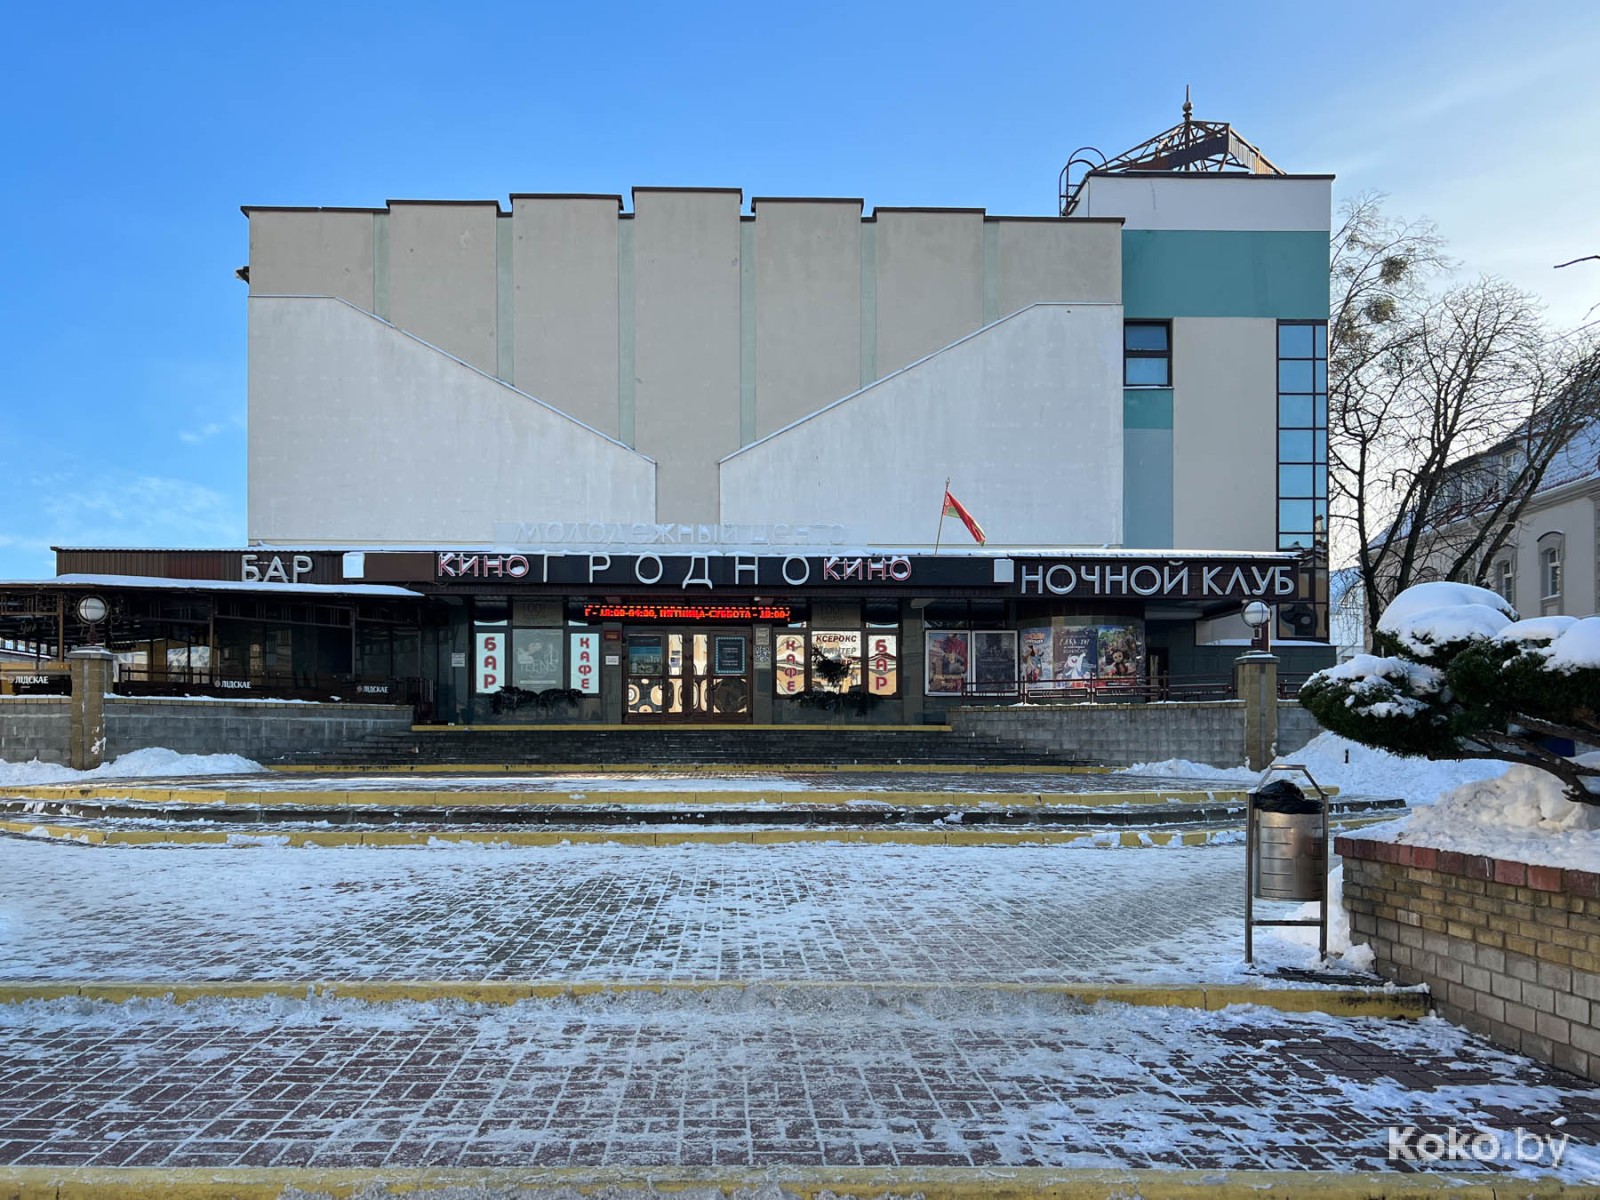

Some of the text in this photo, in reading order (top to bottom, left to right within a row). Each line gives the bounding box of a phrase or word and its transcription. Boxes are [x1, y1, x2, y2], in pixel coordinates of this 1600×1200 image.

[241, 555, 313, 583] БАР
[437, 552, 530, 578] КИНО
[542, 552, 811, 589] ГРОДНО
[823, 555, 912, 581] КИНО
[1021, 560, 1295, 596] НОЧНОЙ КЛУБ
[815, 634, 857, 643] КСЕРОКС
[483, 636, 497, 689] БАР
[577, 637, 592, 689] КАФЕ
[784, 640, 798, 691] КАФЕ
[875, 639, 888, 691] БАР
